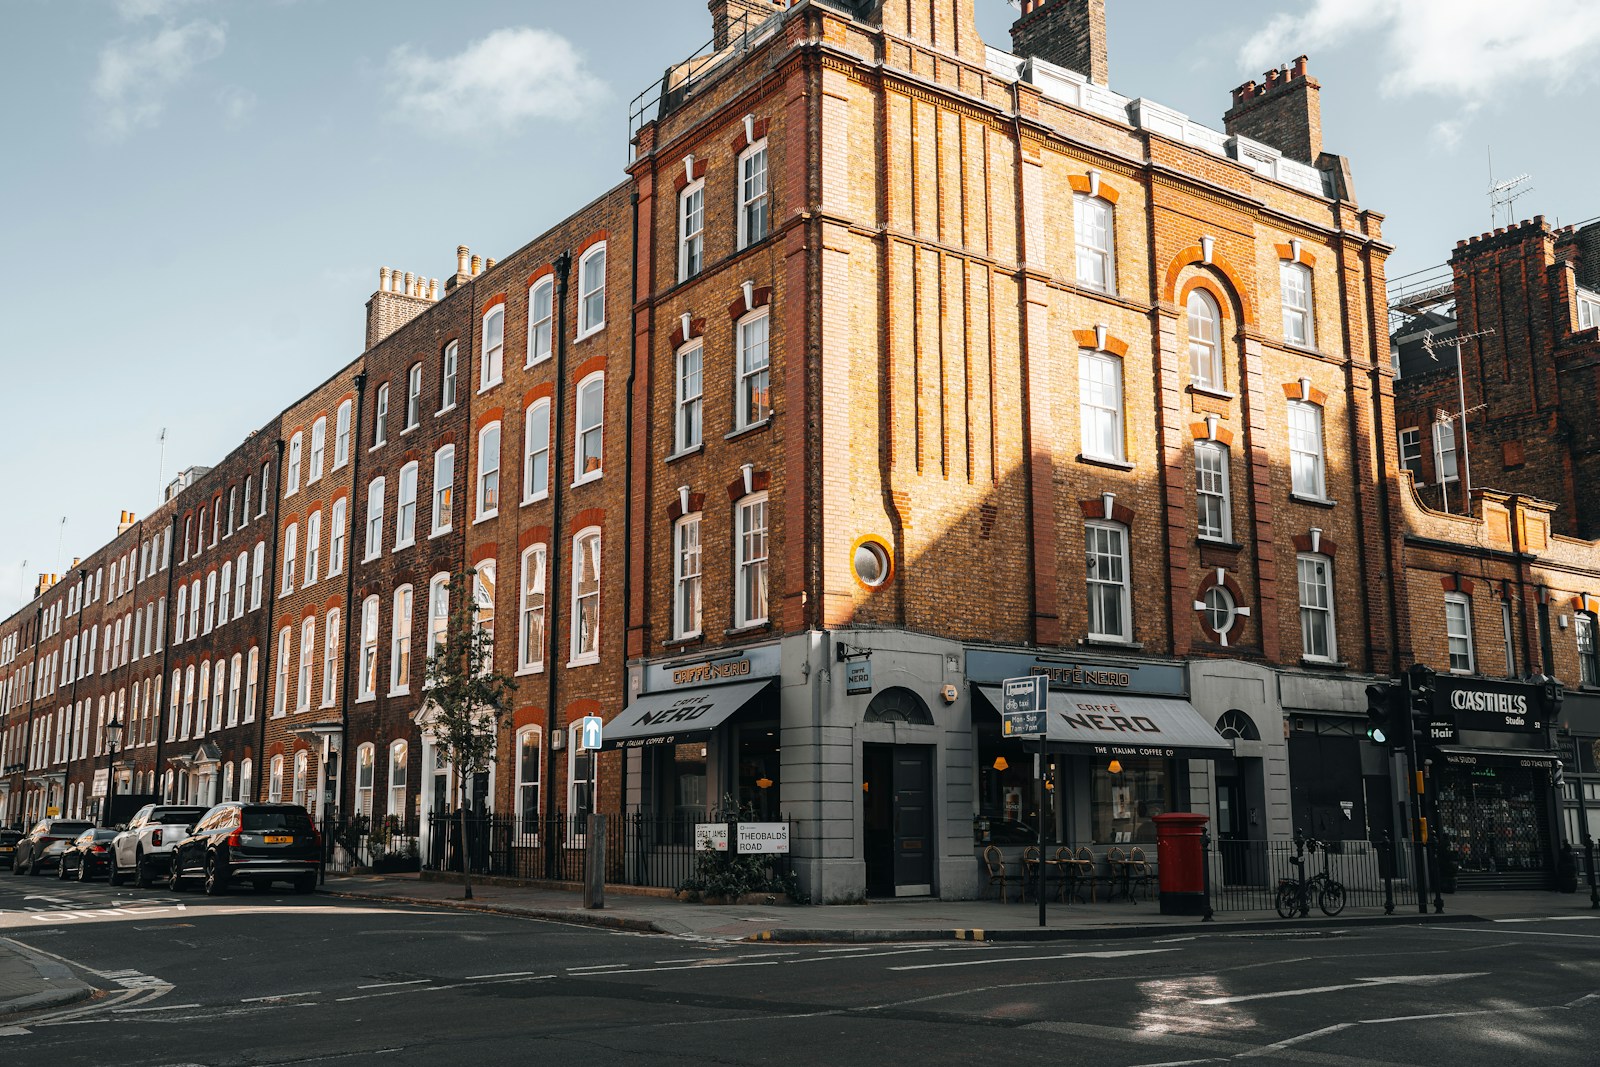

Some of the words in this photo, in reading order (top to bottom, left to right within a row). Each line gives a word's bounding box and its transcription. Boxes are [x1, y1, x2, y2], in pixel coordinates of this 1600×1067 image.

[712, 660, 750, 678] NERO
[848, 674, 868, 683] NERO
[1085, 670, 1130, 686] NERO
[630, 704, 714, 726] NERO
[1059, 712, 1161, 733] NERO
[1505, 716, 1524, 726] Studio
[1431, 728, 1453, 738] Hair
[627, 739, 644, 747] ITALIAN
[646, 737, 664, 745] COFFEE
[1139, 748, 1162, 756] COFFEE
